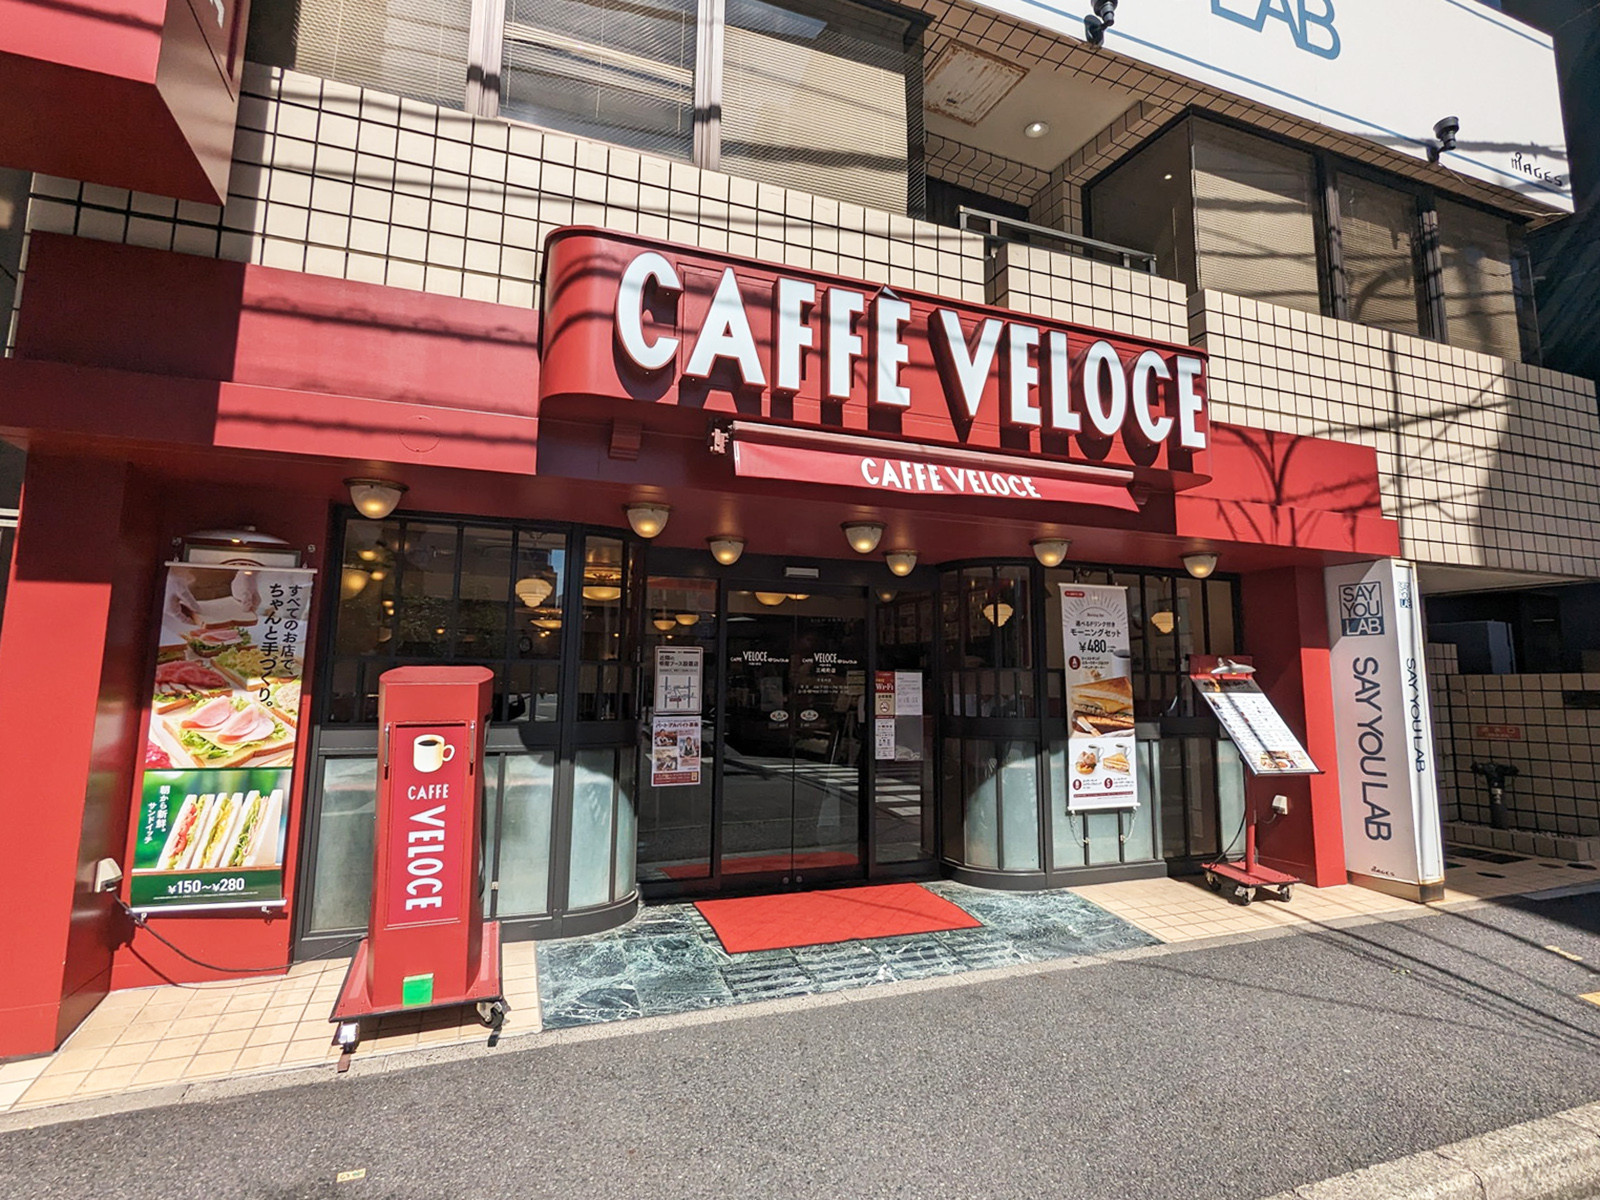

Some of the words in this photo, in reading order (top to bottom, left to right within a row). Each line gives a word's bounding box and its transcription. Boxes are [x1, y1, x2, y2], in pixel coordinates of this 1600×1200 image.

[1210, 0, 1341, 60] LAB
[938, 308, 1207, 450] VELOCE
[945, 466, 1042, 498] VELOCE
[1342, 584, 1377, 602] SAY
[1343, 600, 1380, 618] YOU
[258, 583, 284, 707] ちゃんと手づくり。
[280, 584, 302, 677] すべてのお店で、
[1071, 628, 1121, 638] モーニングセット
[1346, 618, 1381, 635] LAB
[742, 651, 768, 662] VELOCE
[813, 652, 837, 664] VELOCE
[1352, 657, 1382, 712] SAY
[1406, 657, 1419, 698] SAY
[1409, 697, 1422, 735] YOU
[1356, 714, 1387, 777] YOU
[1413, 735, 1426, 773] LAB
[155, 785, 170, 832] 朝から新鮮。
[407, 784, 450, 801] CAFFE
[1361, 781, 1392, 841] LAB
[144, 802, 157, 844] サンドイッチ
[405, 804, 447, 911] VELOCE
